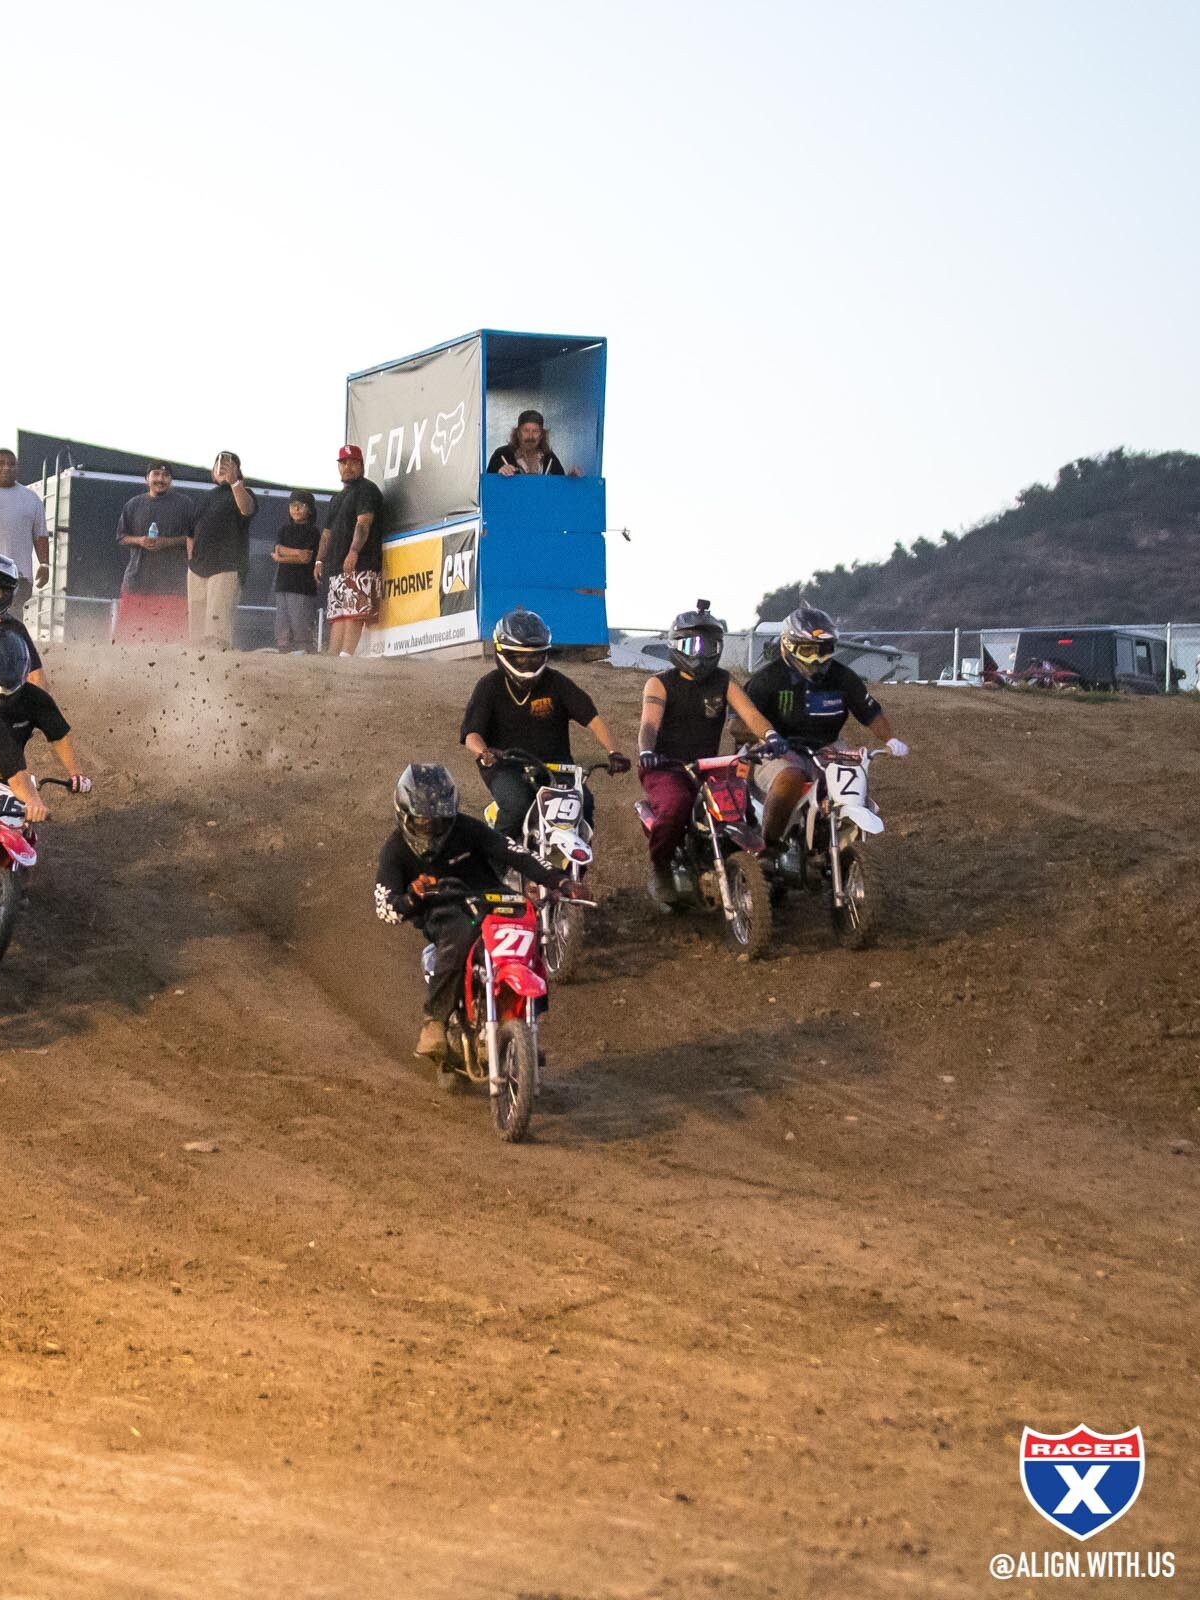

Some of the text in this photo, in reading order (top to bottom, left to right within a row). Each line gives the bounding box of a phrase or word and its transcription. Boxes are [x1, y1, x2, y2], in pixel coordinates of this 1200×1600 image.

[364, 419, 427, 479] FOX
[443, 549, 473, 594] CAT
[393, 626, 466, 651] www.hawthornecat.com
[544, 797, 581, 820] 19
[491, 928, 534, 957] 27
